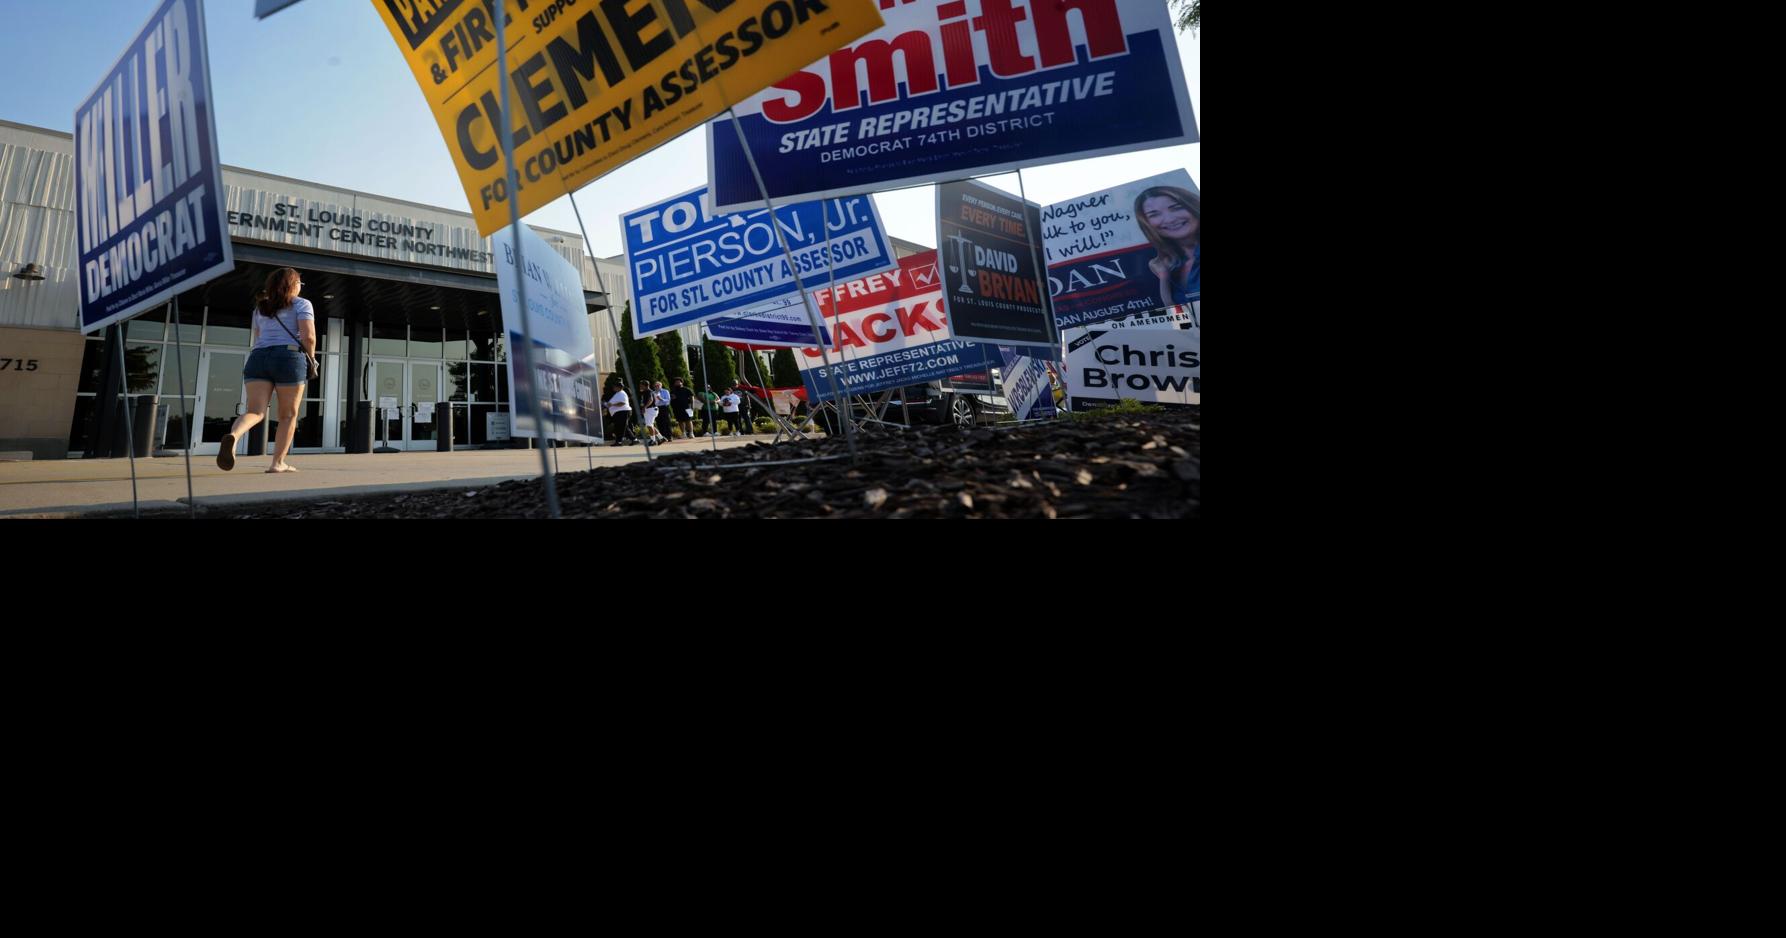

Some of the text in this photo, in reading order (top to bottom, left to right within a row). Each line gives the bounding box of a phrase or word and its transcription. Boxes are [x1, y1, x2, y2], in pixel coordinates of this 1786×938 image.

[430, 63, 448, 85] &
[525, 98, 632, 183] COUNTY
[643, 0, 829, 120] ASSESSOR
[80, 0, 202, 255] MILLER
[779, 71, 1115, 154] STATE REPRESENTATIVE
[820, 137, 912, 163] DEMOCRAT
[918, 130, 961, 147] 74TH
[967, 112, 1055, 138] DISTRICT
[274, 202, 434, 240] ST. LOUIS COUNTY
[961, 205, 998, 229] EVERY
[1070, 220, 1085, 233] to
[1091, 211, 1130, 231] you,
[85, 184, 206, 305] DEMOCRAT
[329, 228, 398, 250] CENTER
[403, 239, 495, 264] NORTHWEST
[635, 210, 815, 291] PIERSON,
[827, 196, 868, 232] Jr.
[975, 245, 1018, 273] DAVID
[650, 236, 869, 316] FOR STL COUNTY ASSESSOR
[978, 299, 995, 308] LOUIS
[995, 301, 1016, 311] COUNTY
[1083, 304, 1125, 320] AUGUST
[1127, 296, 1155, 311] 4TH!
[1074, 335, 1090, 347] VOTE
[1095, 344, 1200, 368] Chris
[0, 358, 39, 372] 715
[819, 340, 976, 378] SAE REPRESENTATIVE
[841, 354, 959, 386] WWW.JEFF72.COM
